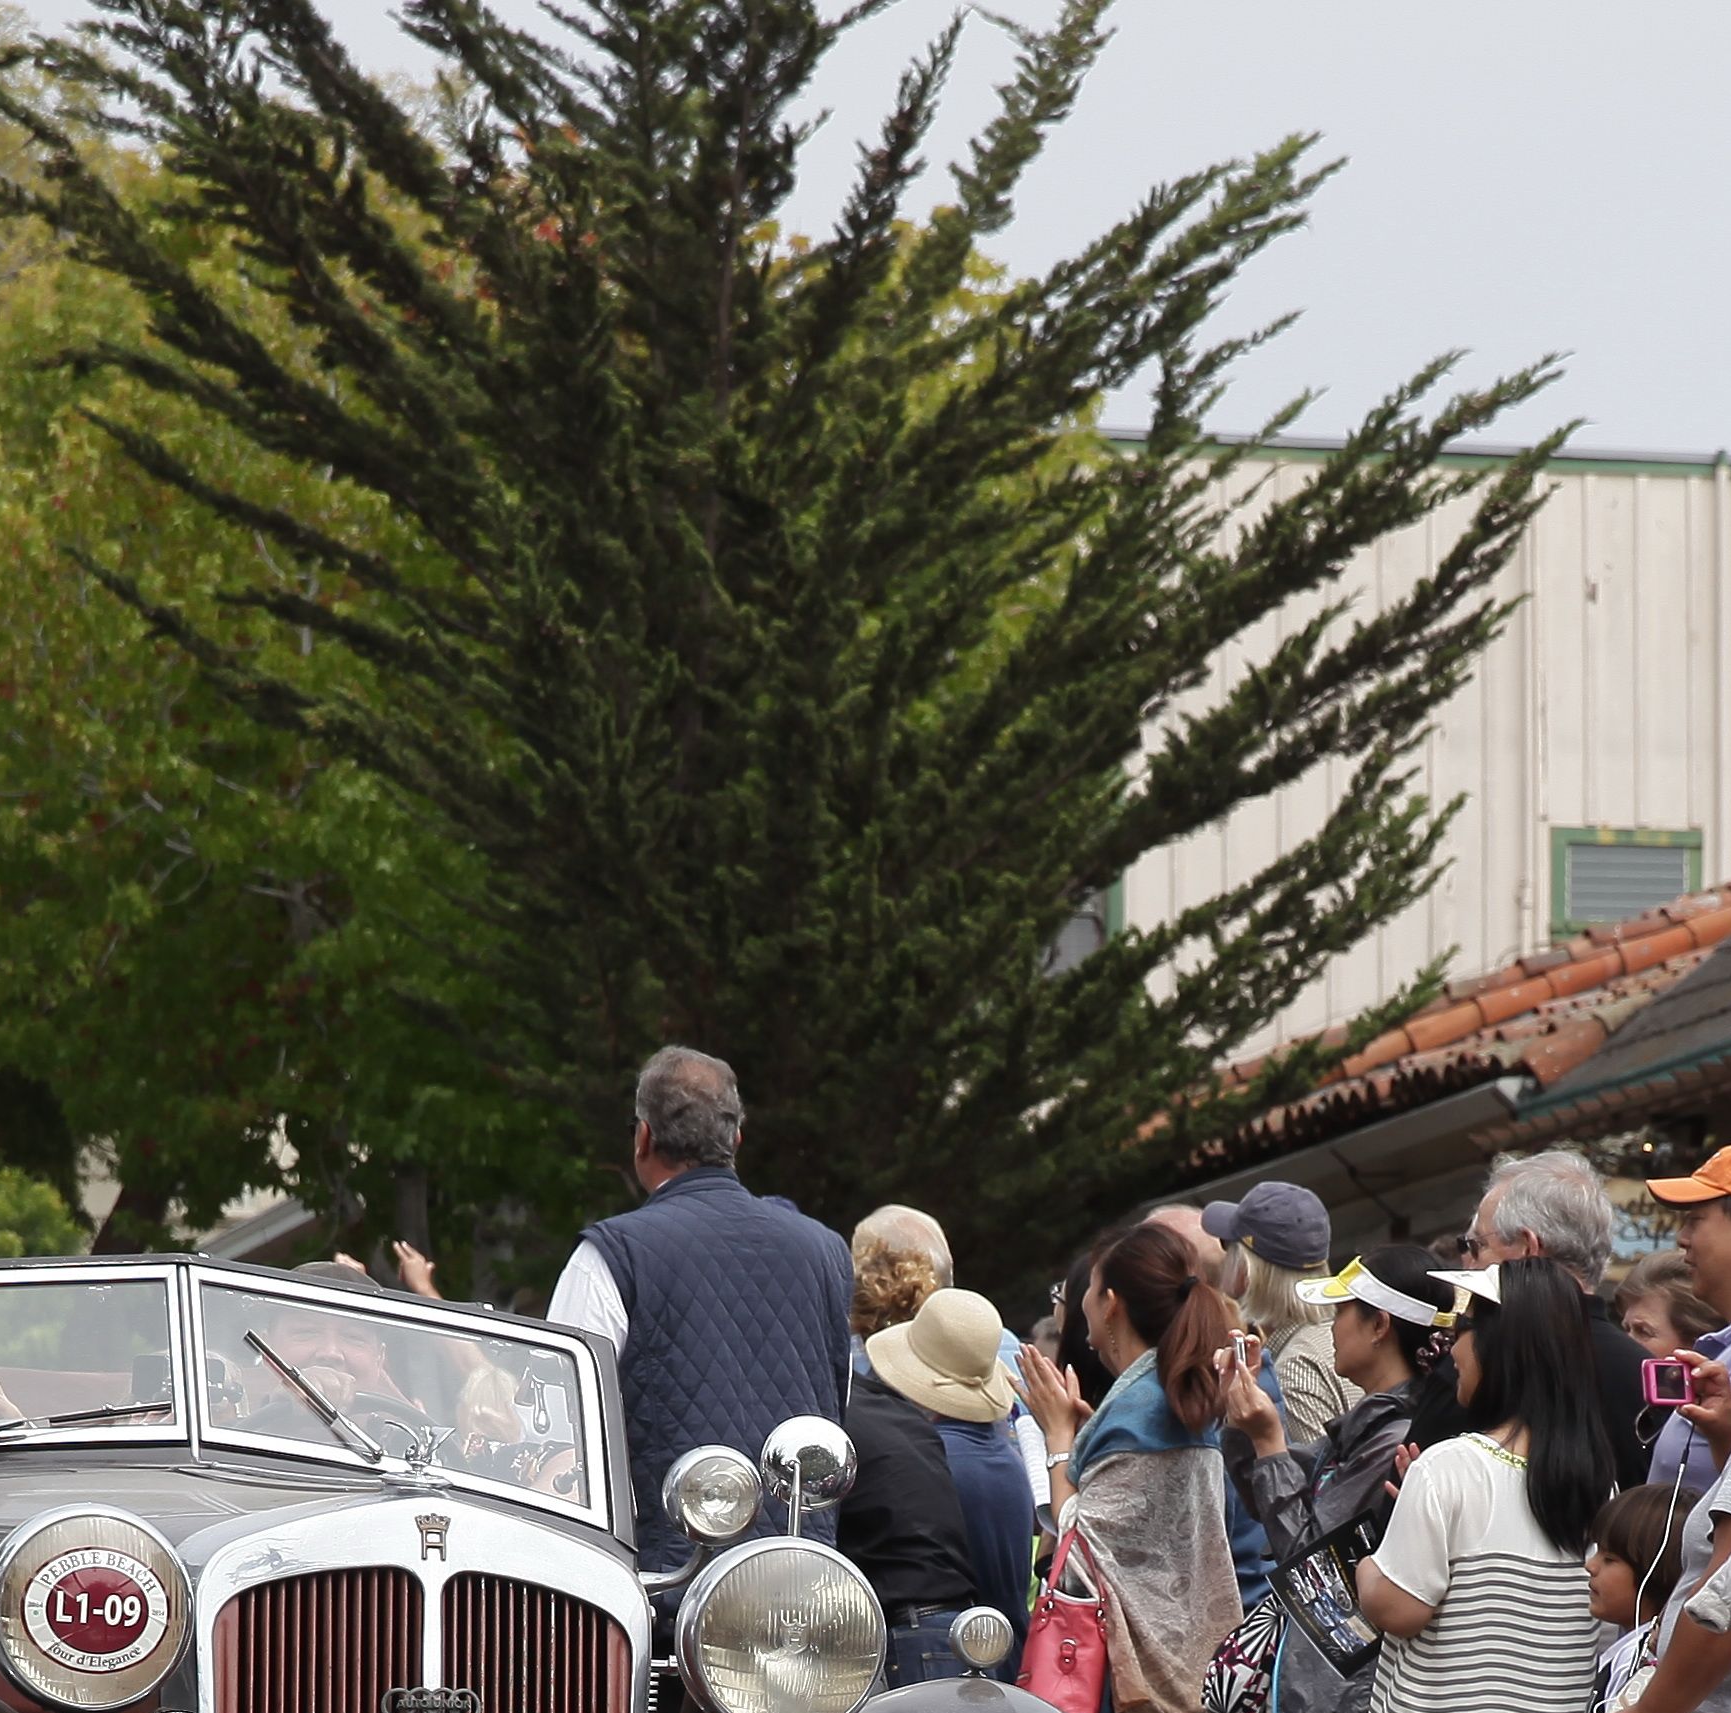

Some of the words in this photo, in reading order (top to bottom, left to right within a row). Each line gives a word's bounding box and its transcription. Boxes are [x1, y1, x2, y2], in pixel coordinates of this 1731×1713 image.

[40, 1552, 102, 1586] PEBBLE
[106, 1552, 157, 1594] BEACH
[55, 1590, 141, 1627] L1-09
[45, 1639, 74, 1662] Tour
